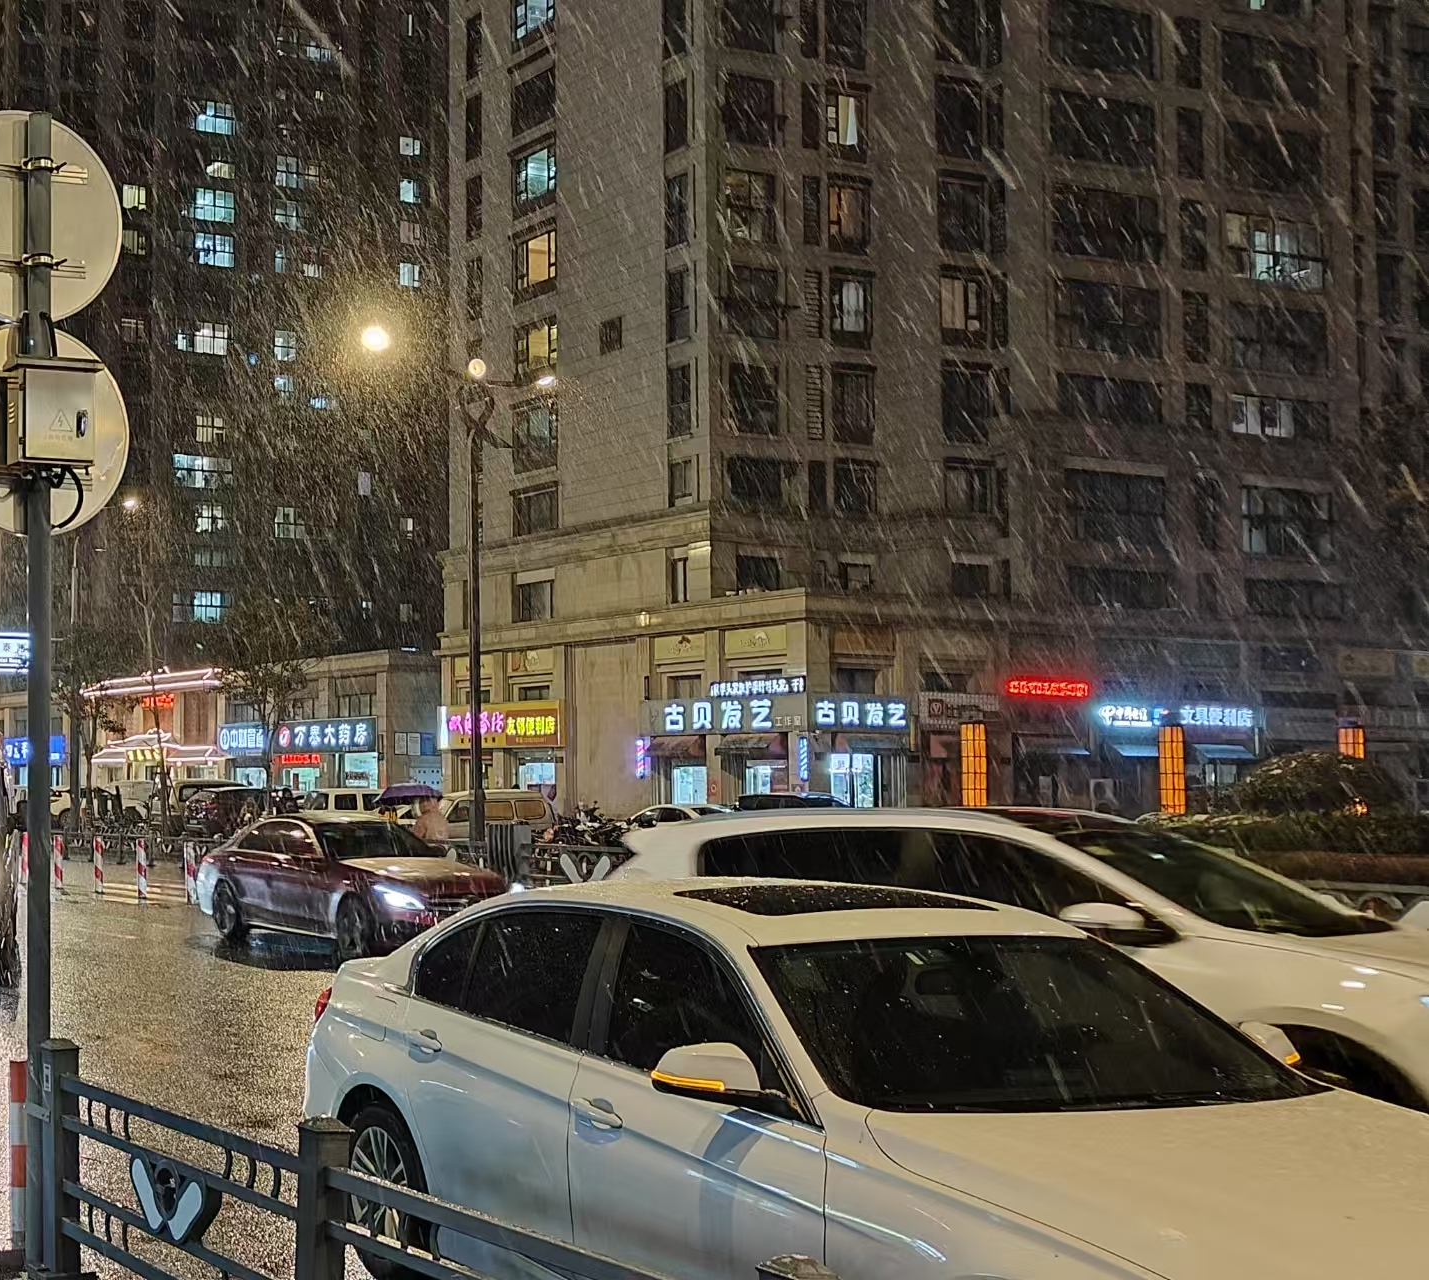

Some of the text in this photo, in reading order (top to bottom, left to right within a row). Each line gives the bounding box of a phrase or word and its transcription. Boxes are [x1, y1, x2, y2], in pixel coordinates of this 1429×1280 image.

[664, 698, 773, 732] 古贝发艺
[816, 700, 907, 728] 古贝发艺
[1179, 706, 1254, 727] 文具便利店
